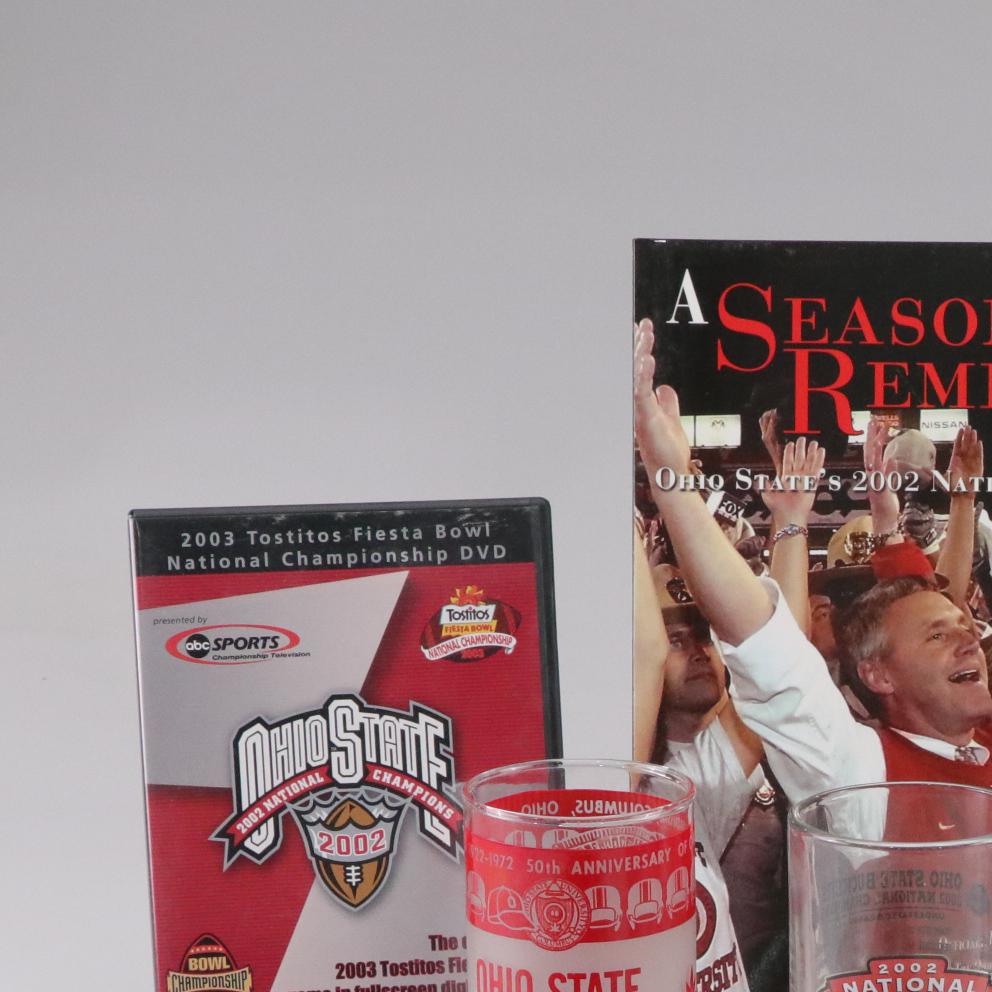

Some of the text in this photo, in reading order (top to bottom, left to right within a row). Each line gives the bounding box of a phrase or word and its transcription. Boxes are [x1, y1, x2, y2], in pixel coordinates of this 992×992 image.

[666, 268, 709, 325] A
[922, 421, 967, 429] NISSAN
[655, 467, 725, 492] OHIO
[852, 470, 920, 492] 2002
[181, 522, 491, 548] 2003 Tostitos Fiesta Bowl
[167, 544, 507, 571] National Championship DVD
[153, 615, 208, 626] presented by
[446, 606, 489, 621] Tostitos
[445, 623, 493, 633] FIESTA BOWL
[185, 635, 280, 651] abc SPORTS
[428, 639, 461, 659] NATIONAL
[461, 634, 512, 647] CHAMPIONSHIP
[212, 650, 311, 661] Championship Television
[236, 770, 454, 834] 2002 NATIONAL CHAMPIONS
[317, 829, 386, 856] 2002
[526, 858, 561, 874] 50th
[571, 847, 671, 875] ANNIVERSARY
[428, 935, 458, 951] The
[188, 956, 230, 971] BOWL
[336, 961, 376, 979] 2003
[380, 958, 445, 977] Tostitos
[878, 962, 937, 975] 2002
